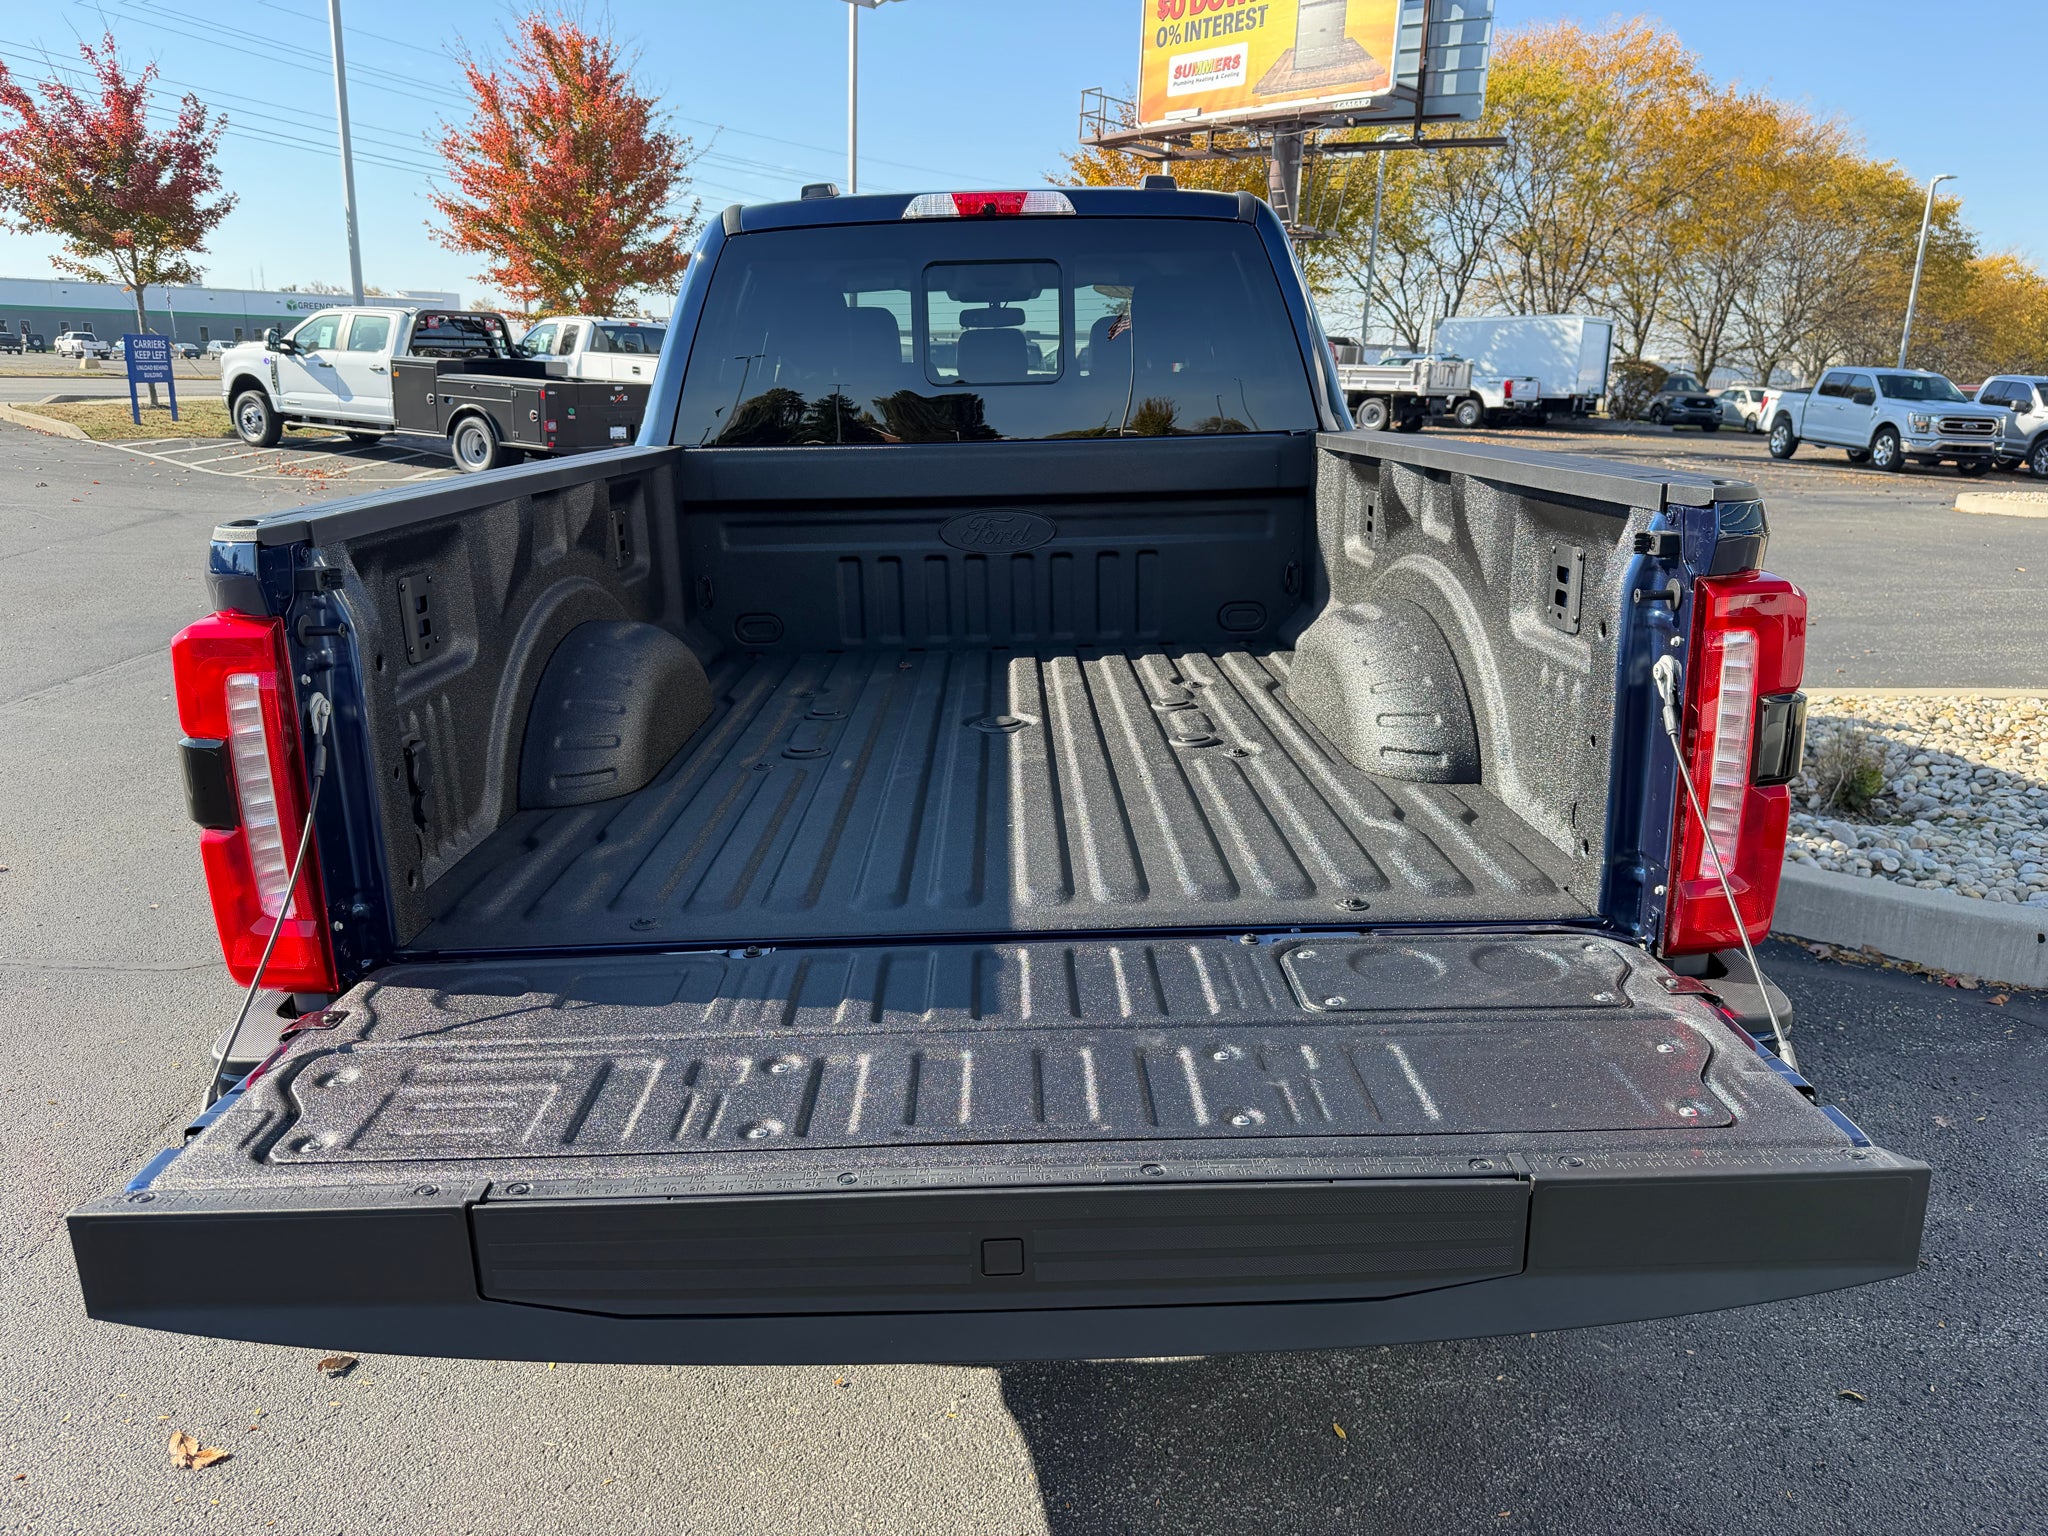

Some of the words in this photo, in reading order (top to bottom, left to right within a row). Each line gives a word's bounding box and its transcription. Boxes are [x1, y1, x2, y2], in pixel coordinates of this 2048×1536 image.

[1156, 23, 1182, 48] 0%
[1183, 4, 1268, 43] INTEREST
[1173, 54, 1241, 80] SUMMERS
[133, 339, 166, 349] CARRIERS
[134, 350, 151, 360] KEEP
[151, 350, 167, 360] LEFT
[961, 516, 1033, 546] Ford
